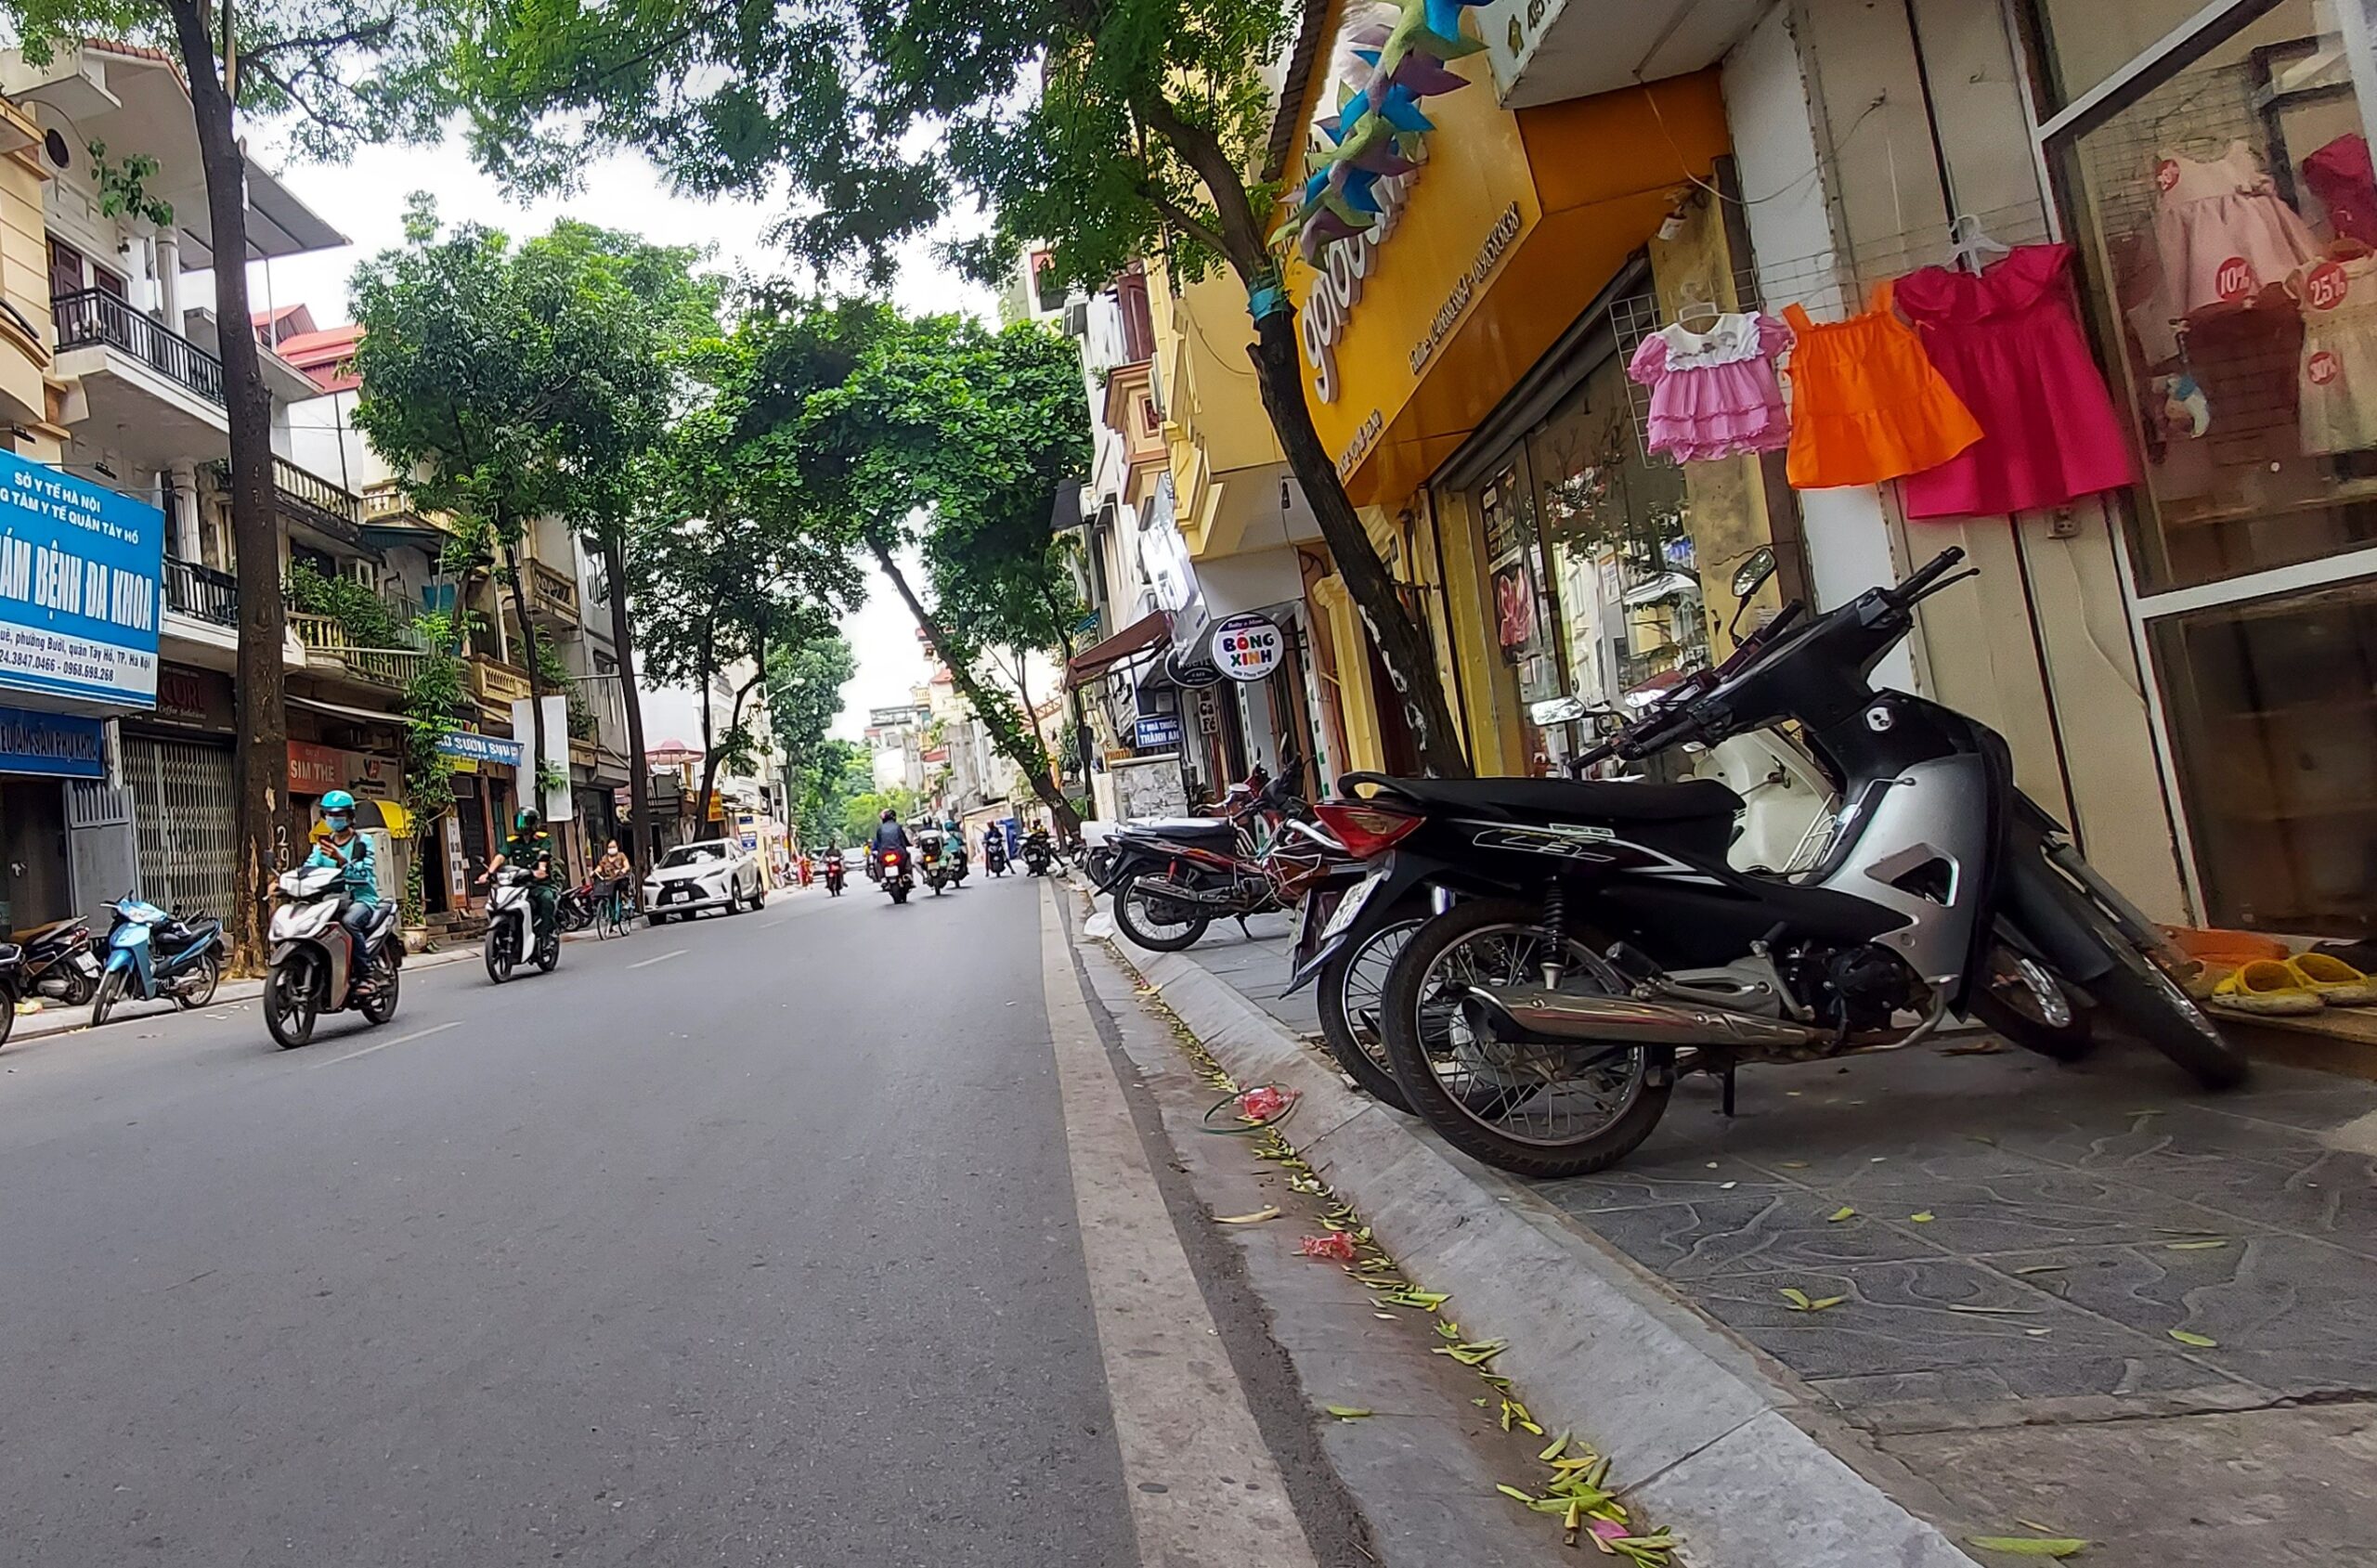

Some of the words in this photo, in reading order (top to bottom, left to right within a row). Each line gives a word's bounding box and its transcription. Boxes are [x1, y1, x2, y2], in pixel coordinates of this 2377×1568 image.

[2220, 264, 2251, 295] 10%
[2310, 268, 2346, 306] 25%
[14, 472, 32, 489] SỞ
[33, 478, 44, 492] Y
[45, 482, 61, 499] TẾ
[62, 489, 79, 506] HÀ
[81, 494, 101, 512] NỘI
[11, 491, 39, 512] TÂM
[40, 501, 49, 514] Y
[51, 504, 68, 521] TẾ
[68, 512, 100, 532] QUẬN
[101, 522, 123, 539] TÂY
[34, 539, 83, 620] BỆNH
[84, 560, 109, 621] ĐA
[110, 568, 153, 631] KHOA
[15, 630, 45, 651] phường
[68, 642, 87, 659] quận
[1223, 628, 1275, 653] BỐNG
[1230, 649, 1272, 667] XINH
[1168, 731, 1179, 741] AN
[291, 759, 312, 780] SIM
